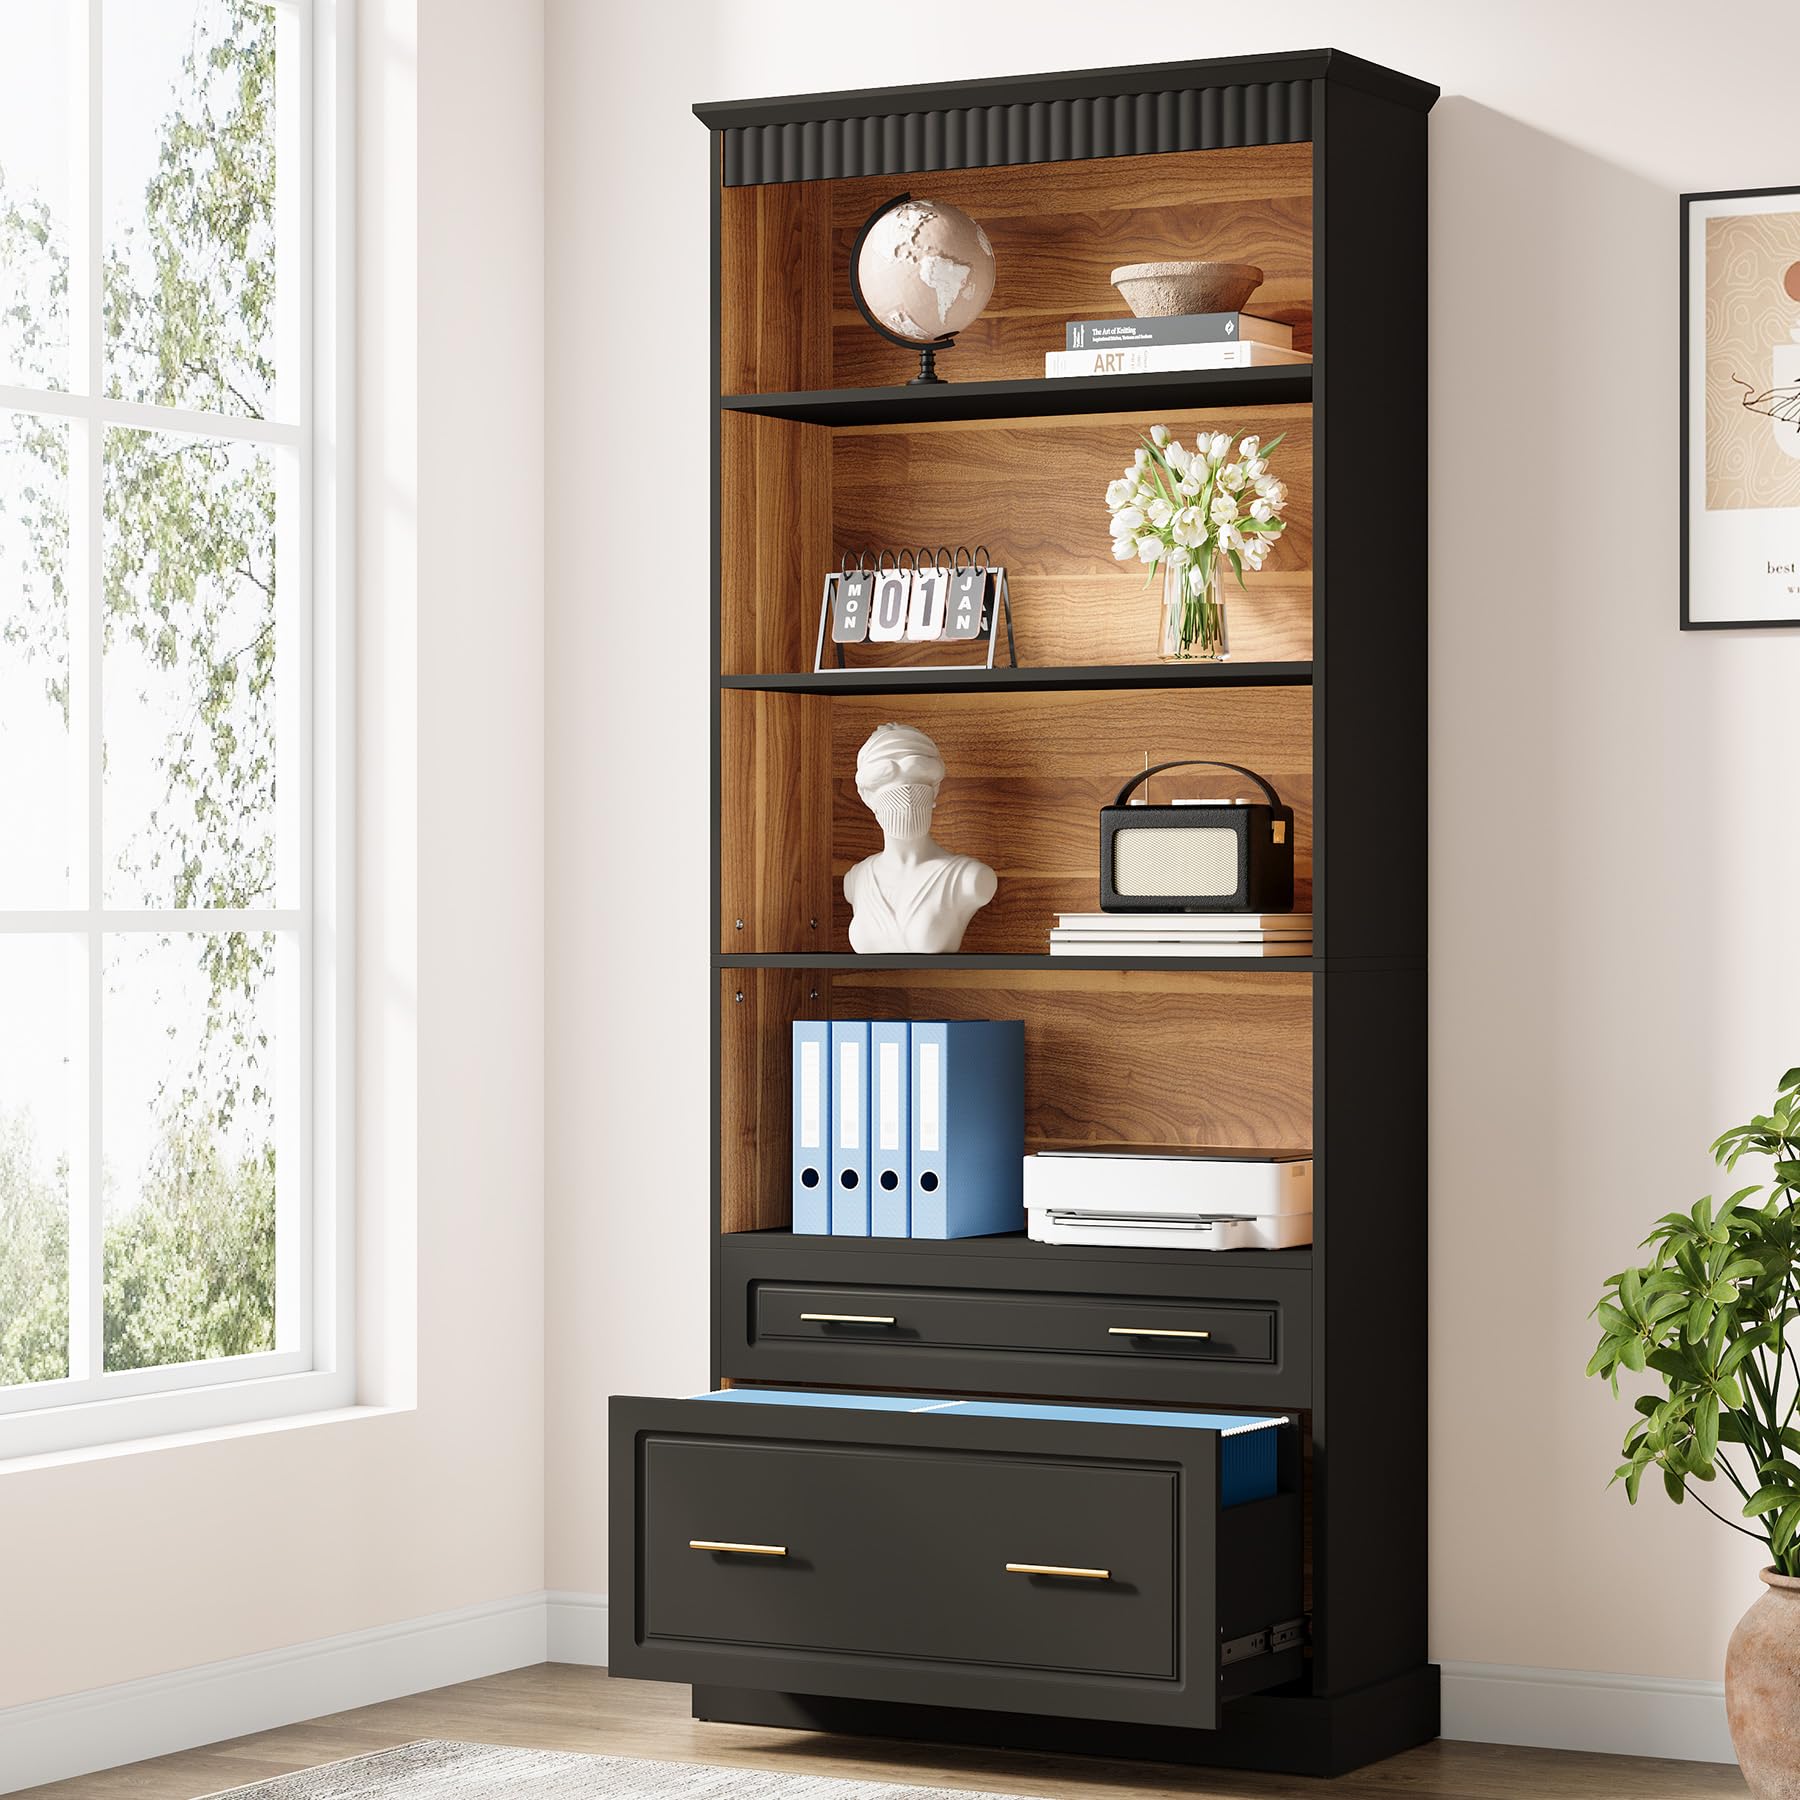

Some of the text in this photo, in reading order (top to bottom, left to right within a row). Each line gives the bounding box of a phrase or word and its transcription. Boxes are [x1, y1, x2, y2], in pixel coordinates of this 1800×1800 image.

[1094, 353, 1125, 373] ART
[1767, 560, 1795, 574] best
[844, 584, 862, 629] MON
[956, 577, 973, 630] JAN
